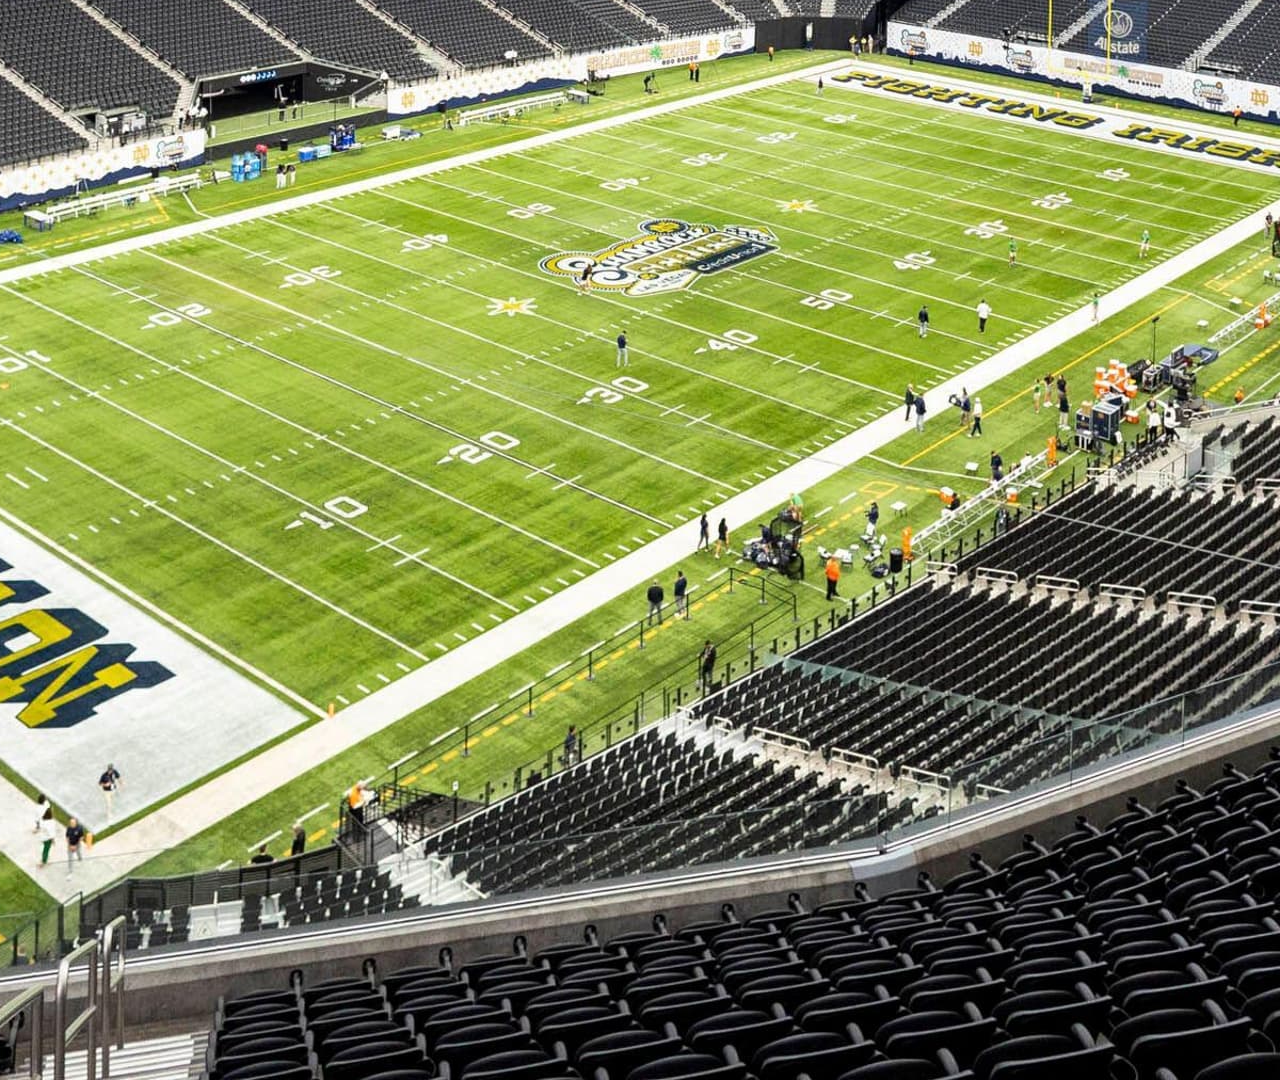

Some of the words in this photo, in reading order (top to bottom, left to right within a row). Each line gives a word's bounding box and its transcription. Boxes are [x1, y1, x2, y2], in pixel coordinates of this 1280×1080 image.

[1093, 36, 1141, 54] Alstate
[830, 70, 1106, 130] FIGHTING
[507, 202, 556, 219] 50
[964, 222, 1009, 239] 30
[403, 234, 449, 251] 40
[893, 252, 936, 271] 40
[288, 265, 342, 286] 30
[800, 288, 854, 311] 50
[149, 302, 212, 327] 20
[708, 329, 758, 351] 40
[586, 376, 648, 404] 30
[449, 431, 520, 465] 20
[302, 495, 368, 530] 10
